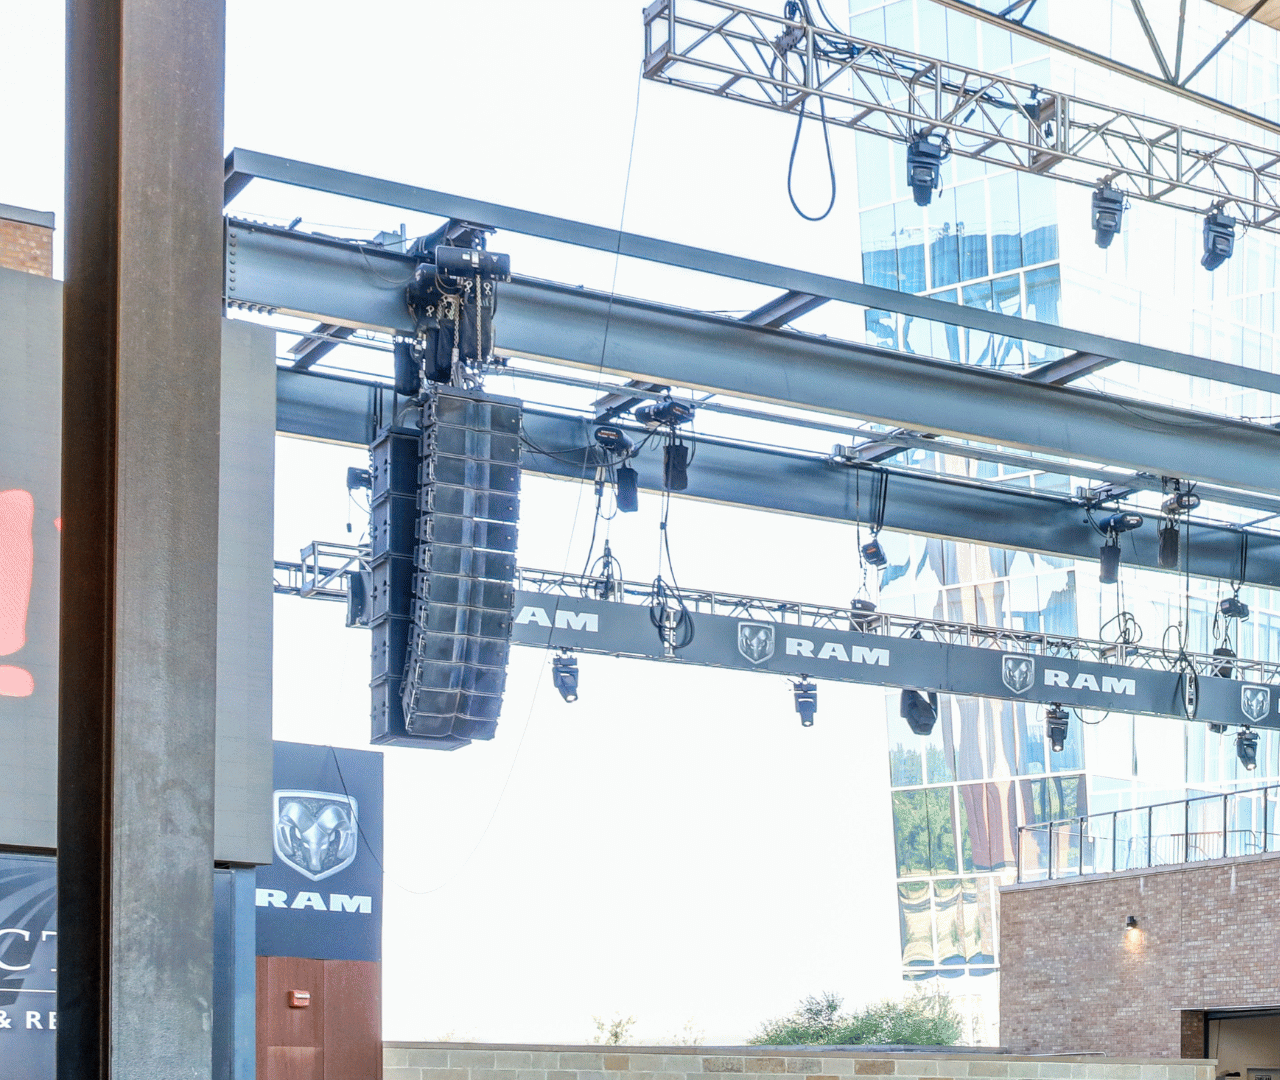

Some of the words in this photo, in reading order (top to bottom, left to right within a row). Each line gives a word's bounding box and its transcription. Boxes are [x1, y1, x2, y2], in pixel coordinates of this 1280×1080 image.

[514, 605, 599, 633] AM
[785, 637, 891, 667] RAM
[1043, 668, 1136, 696] RAM
[254, 887, 373, 914] RAM
